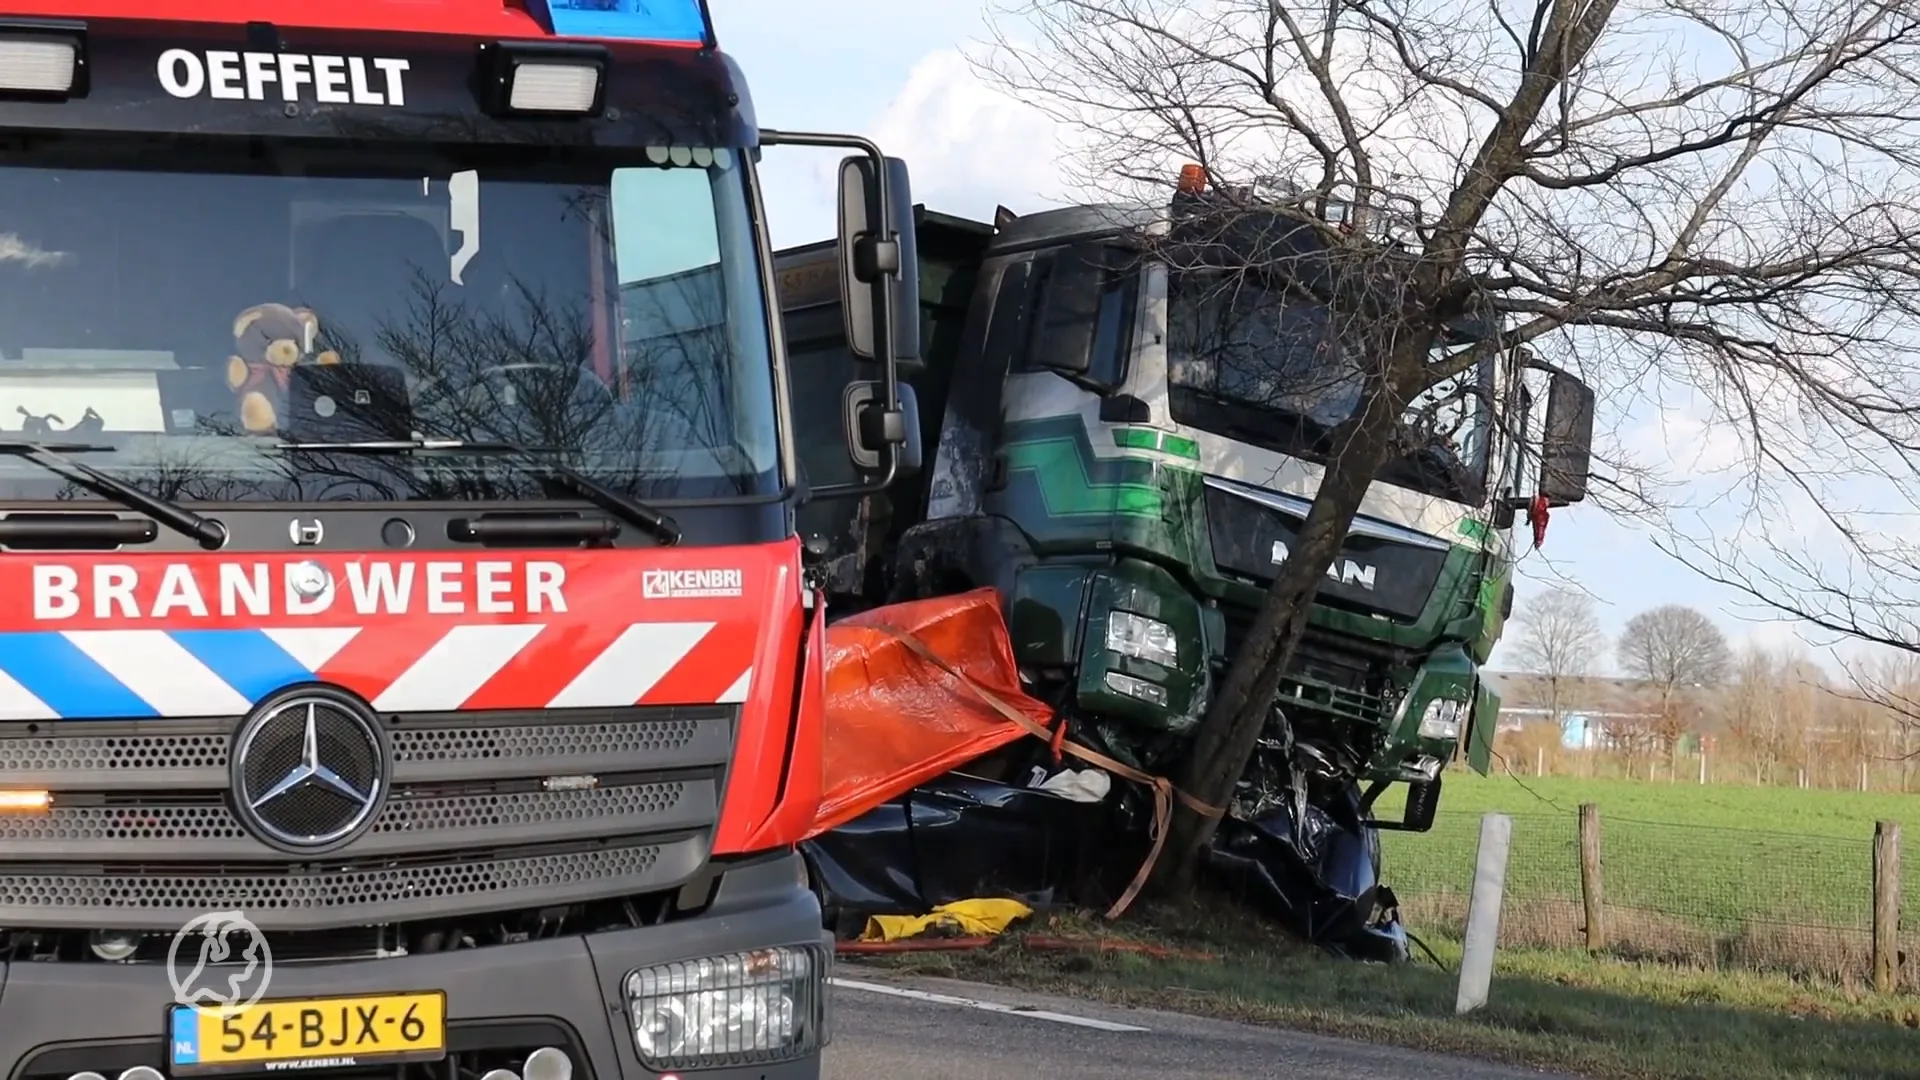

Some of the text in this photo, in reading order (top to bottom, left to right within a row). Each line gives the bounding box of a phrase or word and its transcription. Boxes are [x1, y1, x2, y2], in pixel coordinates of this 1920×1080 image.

[157, 48, 411, 106] OEFFELT
[32, 561, 568, 621] BRANDWEER
[670, 569, 743, 589] KENBRI
[176, 1043, 195, 1055] NL
[222, 1003, 425, 1052] 54-BJX-6
